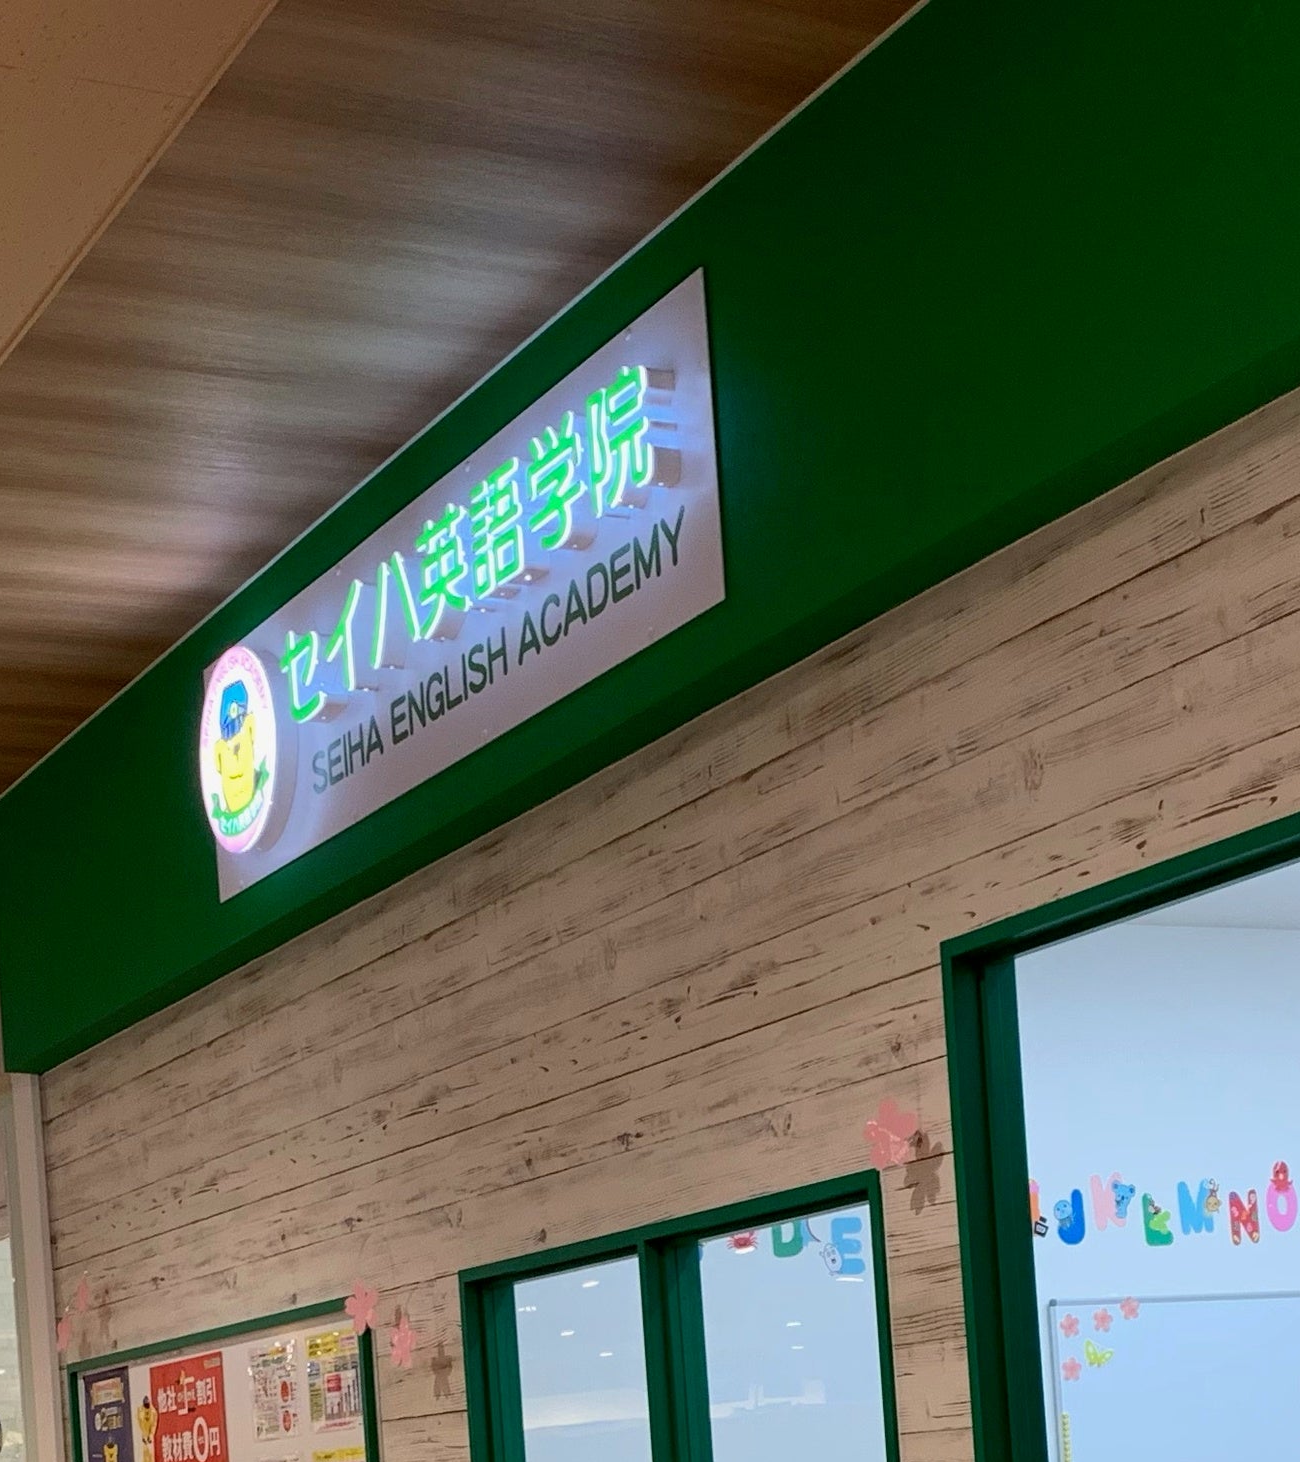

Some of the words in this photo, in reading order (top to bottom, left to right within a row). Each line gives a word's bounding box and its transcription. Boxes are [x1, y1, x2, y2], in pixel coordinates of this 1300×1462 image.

[279, 364, 654, 725] セイハ英語学院
[311, 716, 385, 795] SEIHA
[390, 627, 509, 748] ENGLISH
[517, 505, 686, 666] ACADEMY
